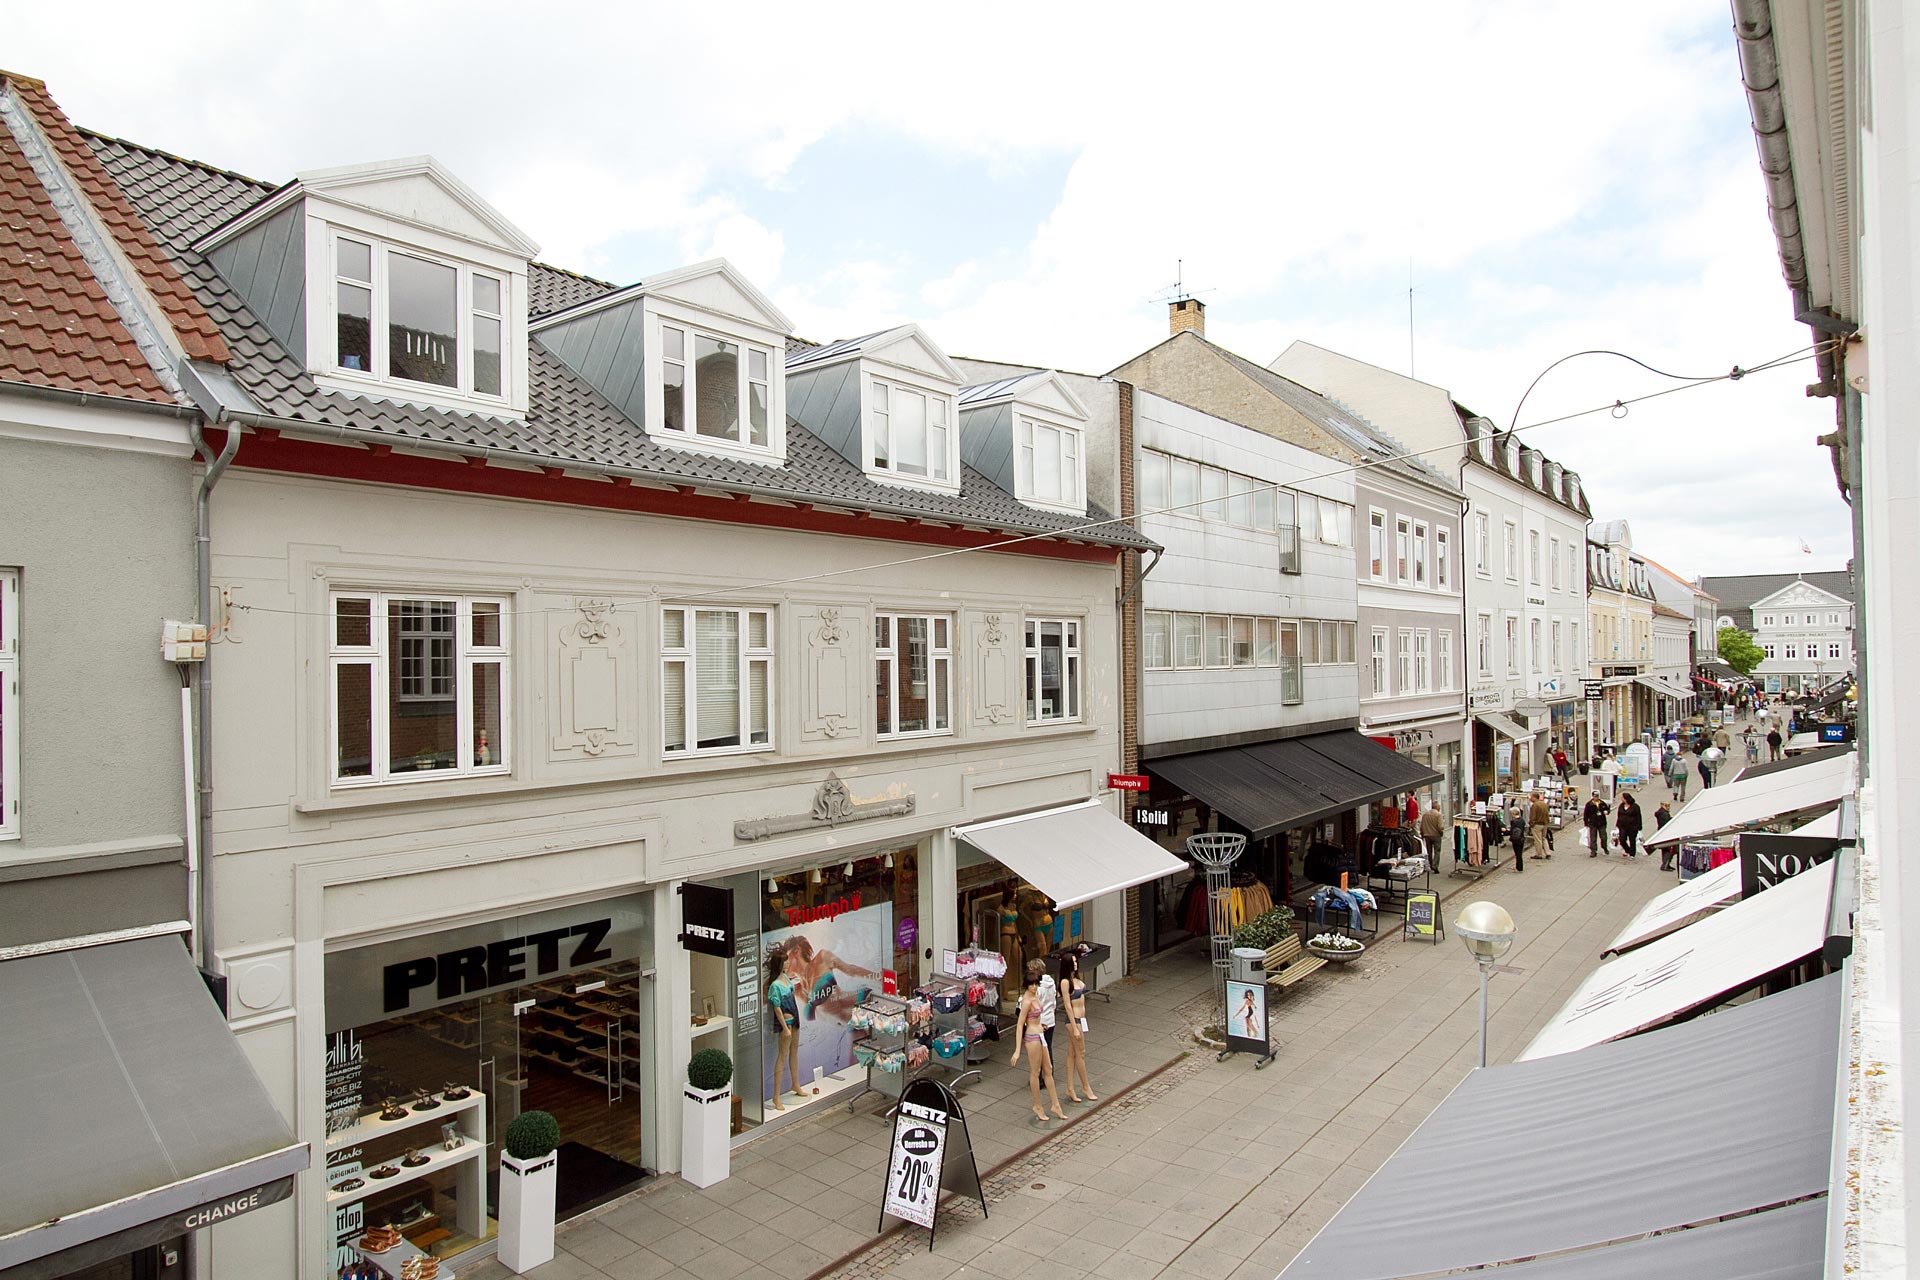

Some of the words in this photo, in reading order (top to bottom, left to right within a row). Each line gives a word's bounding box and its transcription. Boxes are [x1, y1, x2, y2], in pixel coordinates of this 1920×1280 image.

[1113, 779, 1137, 787] Triumph
[1137, 809, 1168, 825] !Solid
[784, 896, 849, 927] Triumph
[1411, 910, 1431, 919] SALE
[685, 923, 725, 942] PRETZ
[383, 917, 612, 1013] PRETZ
[736, 955, 758, 967] Clarks
[325, 1085, 348, 1097] SHOE
[349, 1081, 362, 1092] BIZ
[326, 1094, 362, 1111] wonders
[333, 1103, 361, 1117] BRONX
[902, 1101, 947, 1124] PRETZ
[326, 1147, 363, 1166] Clarks
[897, 1155, 933, 1203] -20%
